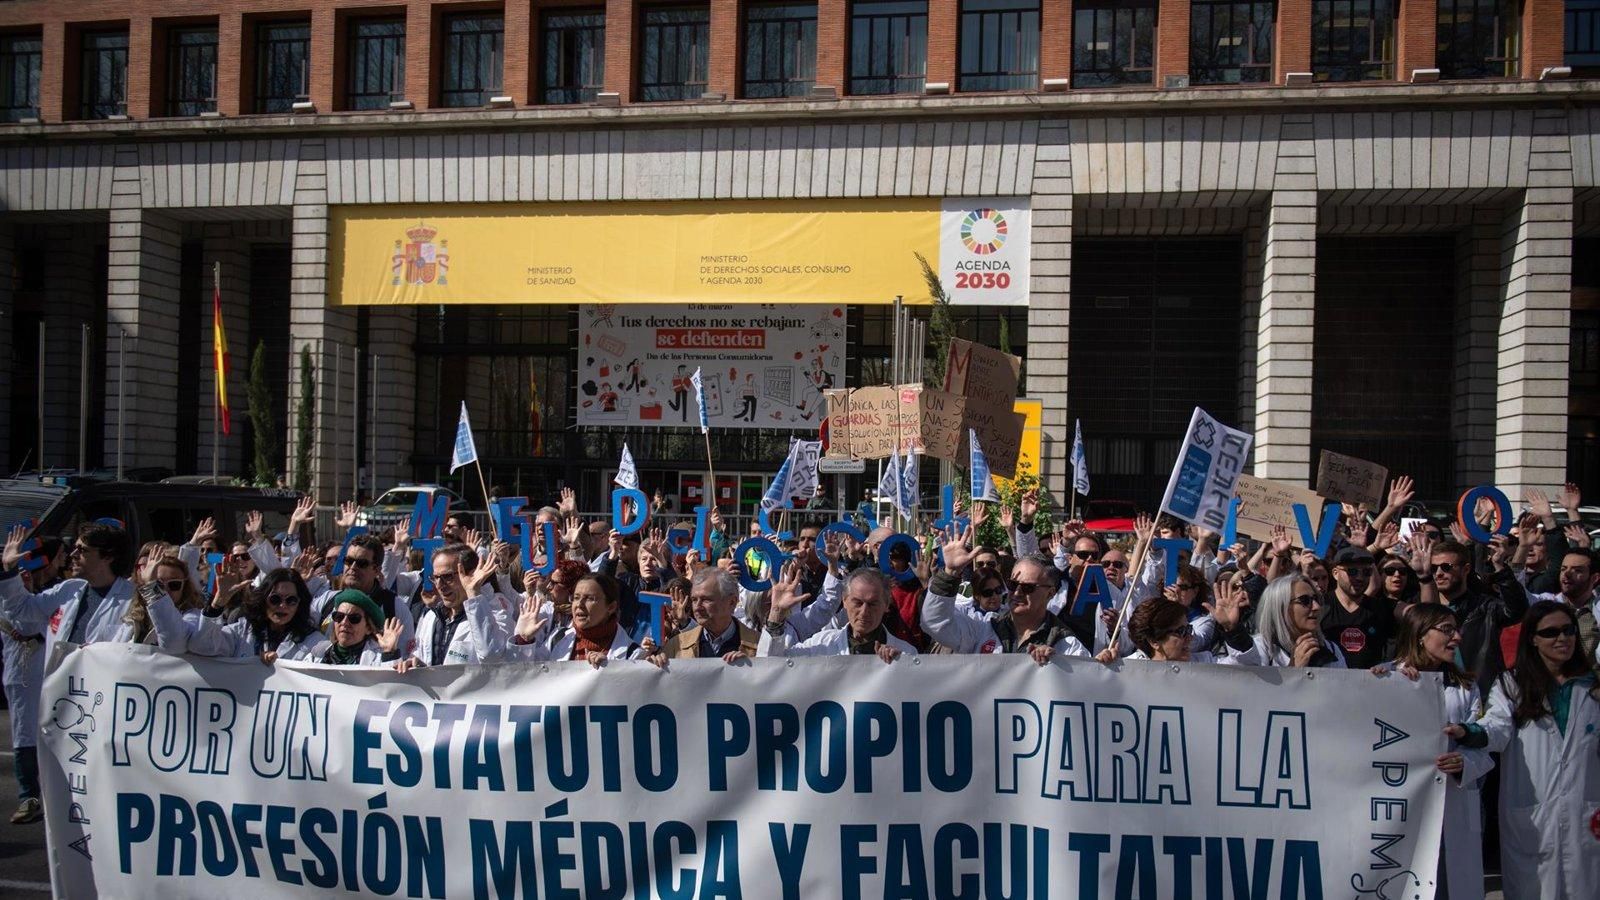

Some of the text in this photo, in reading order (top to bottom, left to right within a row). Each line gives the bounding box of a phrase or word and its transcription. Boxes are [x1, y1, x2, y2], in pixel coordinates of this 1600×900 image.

[701, 255, 748, 264] MINISTERIO
[955, 260, 1011, 271] AGENDA
[527, 266, 573, 275] MINISTERIO
[700, 265, 851, 275] DE DERECHOS SOCIALES, CONSUMO
[527, 277, 577, 286] DE SANIDAD
[700, 276, 763, 285] Y AGENDA 2030
[955, 272, 1010, 289] 2030
[620, 313, 805, 333] Tus derechos no se rebajan:
[656, 331, 764, 347] se defienden
[684, 353, 717, 361] Personas
[881, 399, 897, 411] LAS
[925, 393, 945, 412] UN
[832, 412, 919, 428] GUARDIAS TAMPOCO
[833, 429, 844, 439] SE
[850, 427, 898, 440] SOLUCIONAN
[831, 440, 874, 455] PASTILLAS
[1238, 480, 1250, 489] NO
[113, 682, 1312, 810] POR UN ESTATUTO PROPIO PARA LA
[116, 790, 447, 899] PROFESIÓN
[469, 797, 745, 900] MÉDICA
[768, 821, 813, 900] Y
